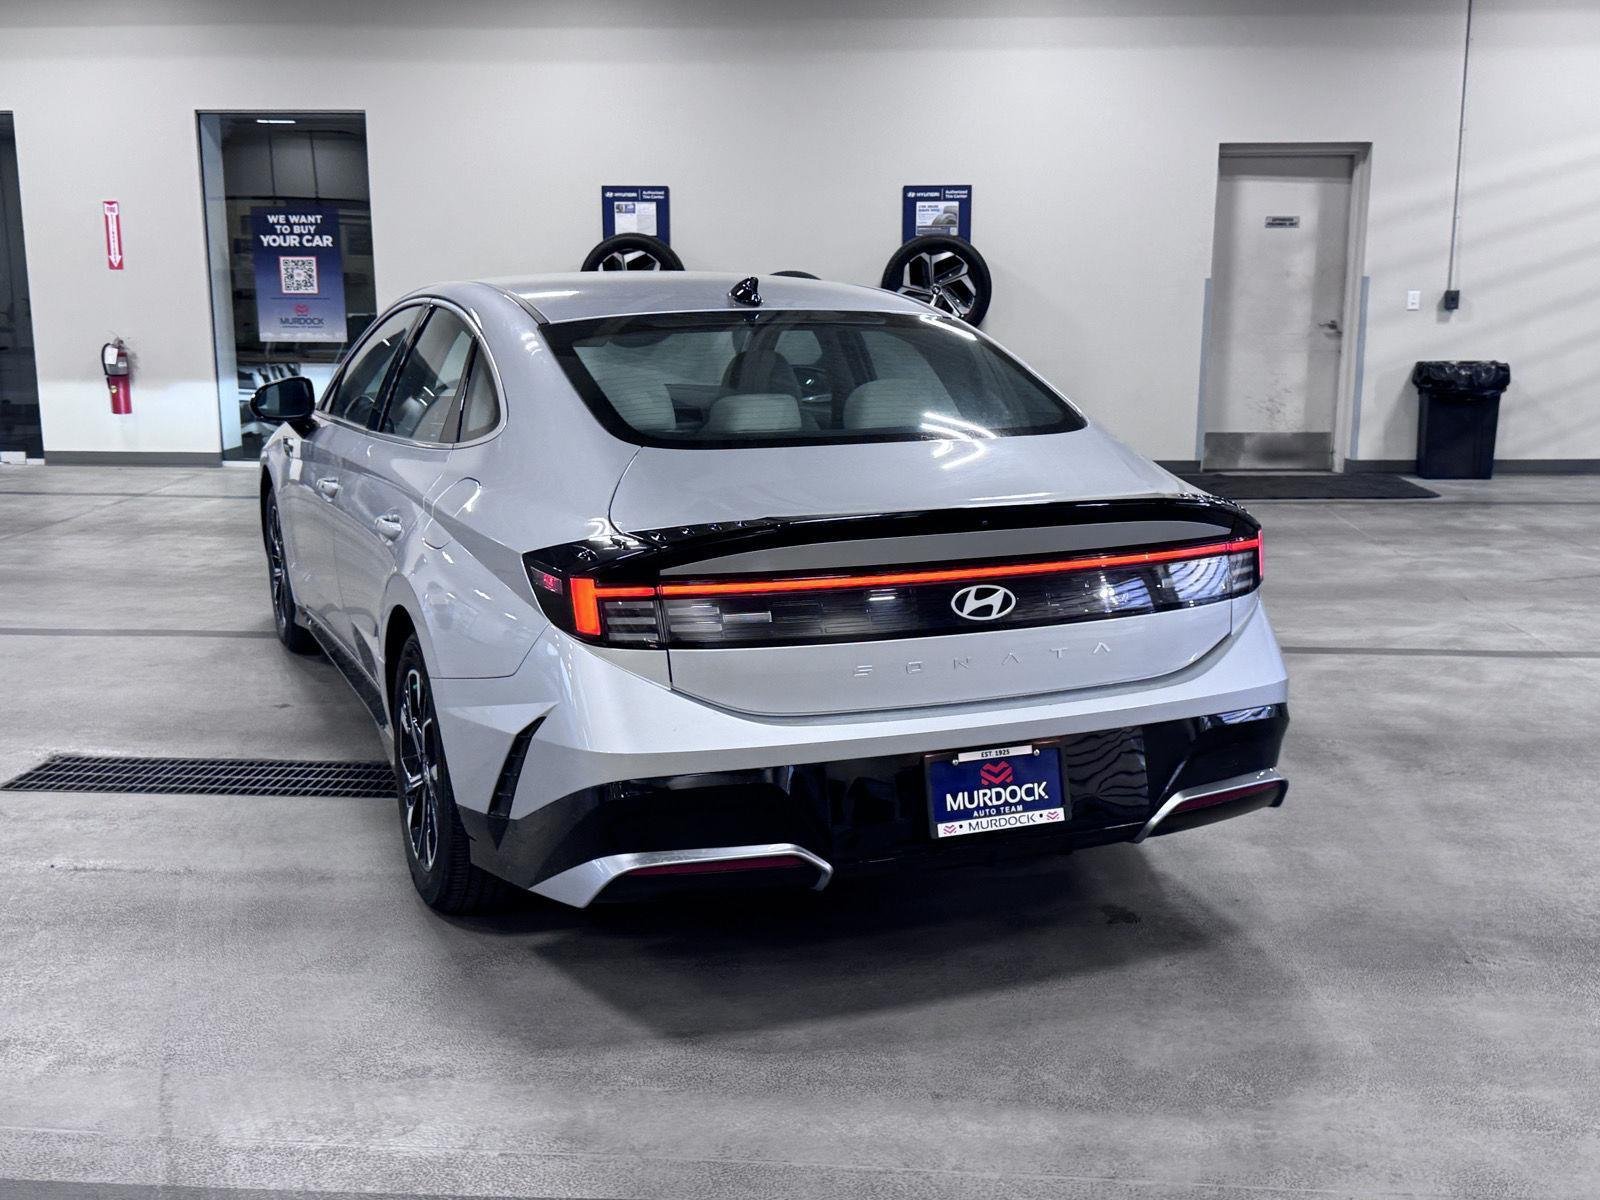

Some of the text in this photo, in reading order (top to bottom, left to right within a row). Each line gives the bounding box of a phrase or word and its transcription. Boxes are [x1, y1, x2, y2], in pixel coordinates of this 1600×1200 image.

[267, 214, 322, 224] WE WANT
[275, 225, 316, 234] TO BUY
[260, 235, 333, 247] YOUR CAR
[280, 317, 324, 325] MURDOCK
[854, 641, 1111, 677] SONATA
[945, 781, 1049, 811] MURDOCK
[973, 804, 1023, 818] AUTO TEAM
[968, 813, 1036, 832] MURDOCK
